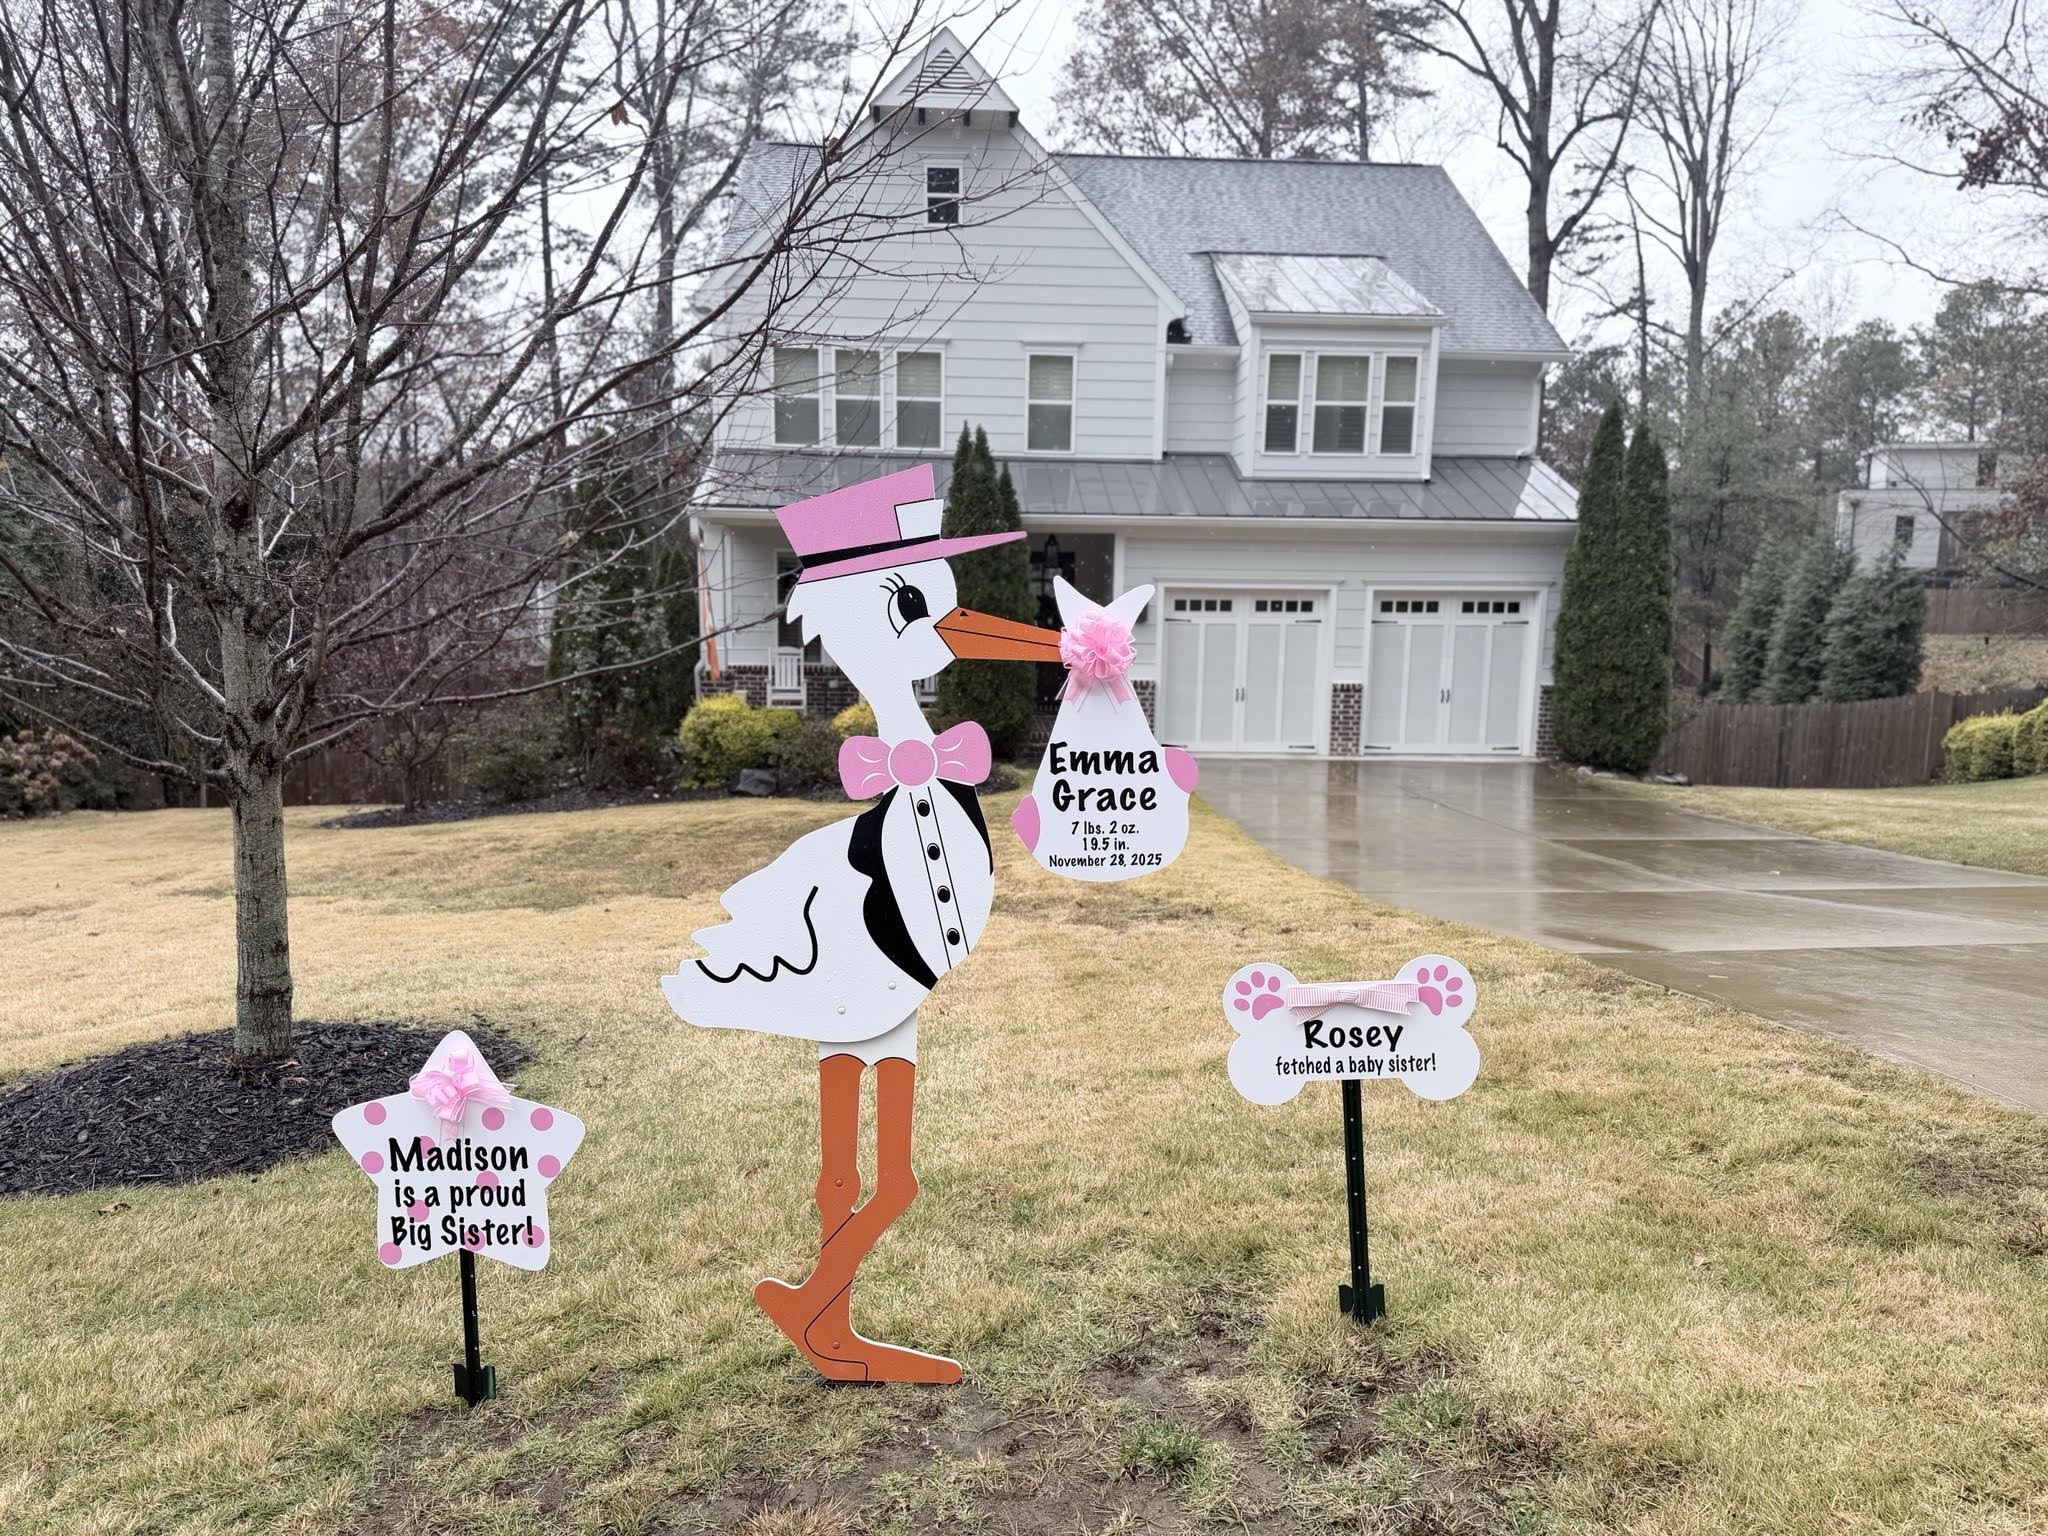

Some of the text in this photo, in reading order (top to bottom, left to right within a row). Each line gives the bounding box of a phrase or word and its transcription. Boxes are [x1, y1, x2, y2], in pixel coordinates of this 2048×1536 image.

[1050, 741, 1159, 775] Emma
[1053, 779, 1157, 812] Grace
[1071, 820, 1140, 835] 7 lbs. 2 oz.
[1082, 837, 1130, 851] 19.5 in.
[1049, 853, 1163, 868] November 28, 2025
[1303, 1020, 1403, 1052] Rosey
[1275, 1052, 1436, 1076] fetched a baby sister!
[389, 1137, 528, 1172] Madison
[395, 1179, 525, 1213] is a proud
[391, 1215, 533, 1250] Big Sister!
